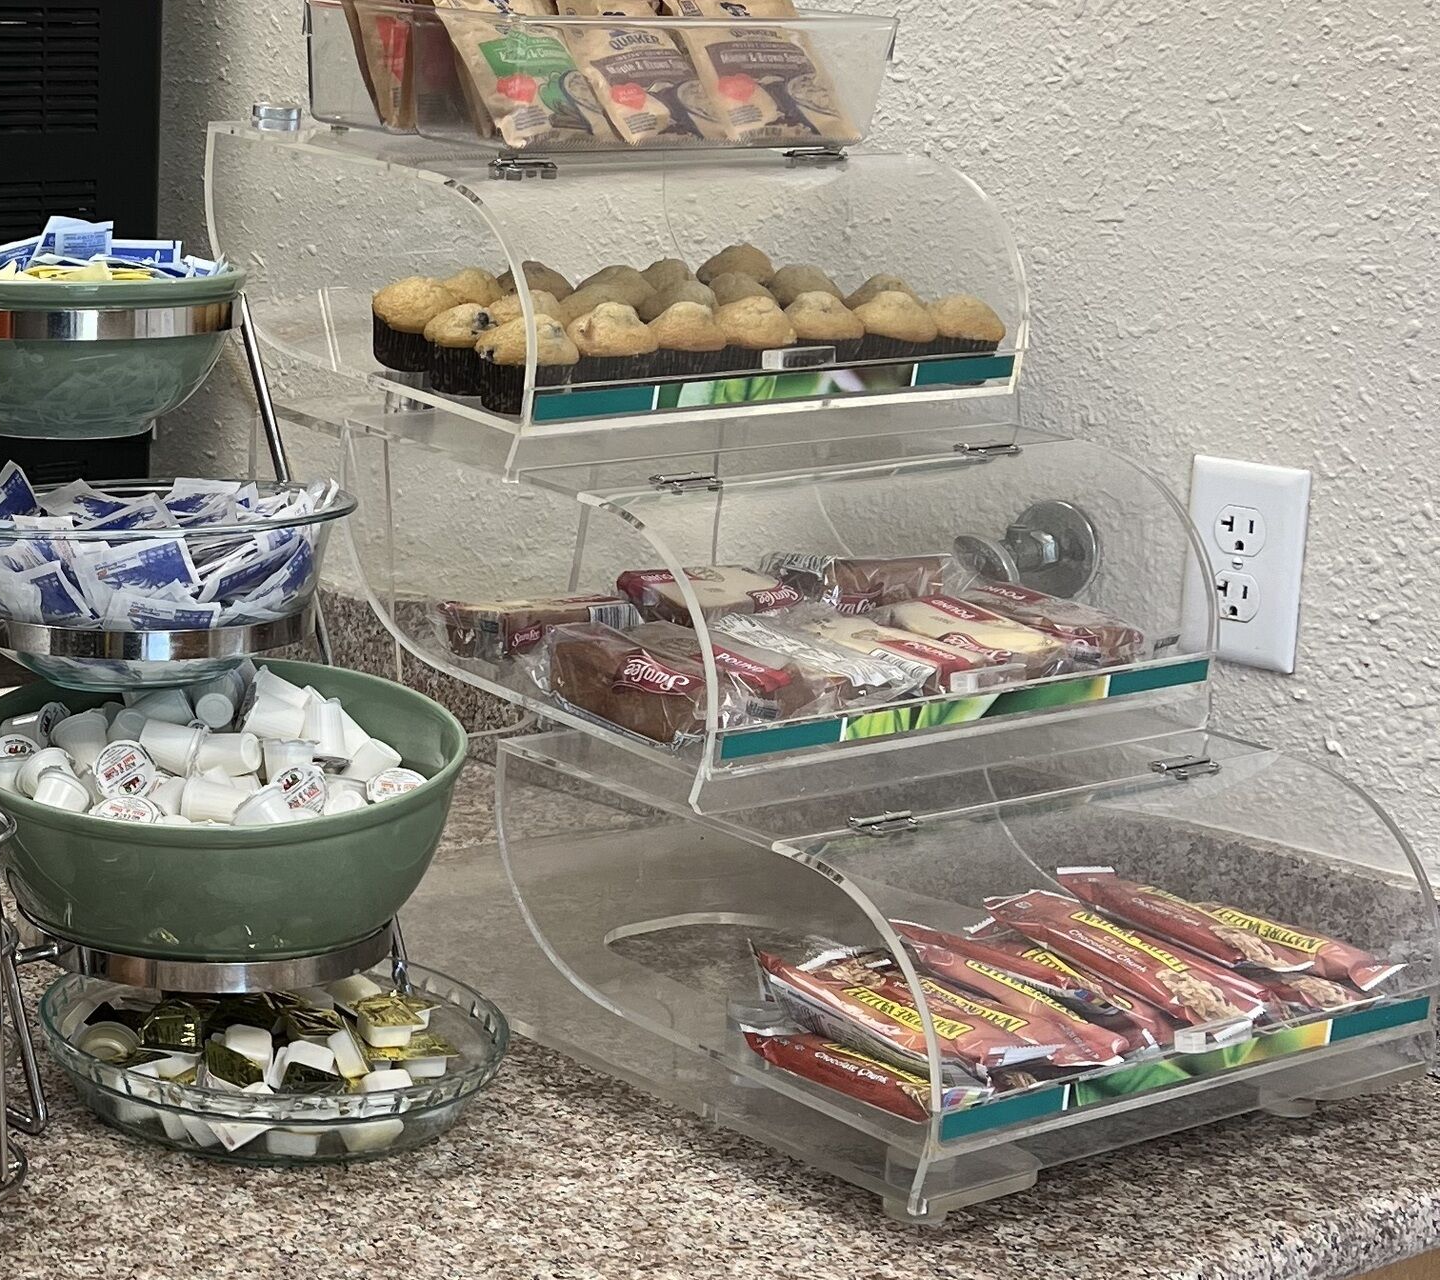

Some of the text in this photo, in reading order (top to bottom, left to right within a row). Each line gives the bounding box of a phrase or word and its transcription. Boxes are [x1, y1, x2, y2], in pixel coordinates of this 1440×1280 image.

[608, 32, 659, 51] QUAKER
[715, 652, 766, 673] POUND
[1263, 923, 1316, 950] NATURE
[1069, 928, 1148, 974] Chocolate Chunk
[896, 1002, 964, 1036] NAURE
